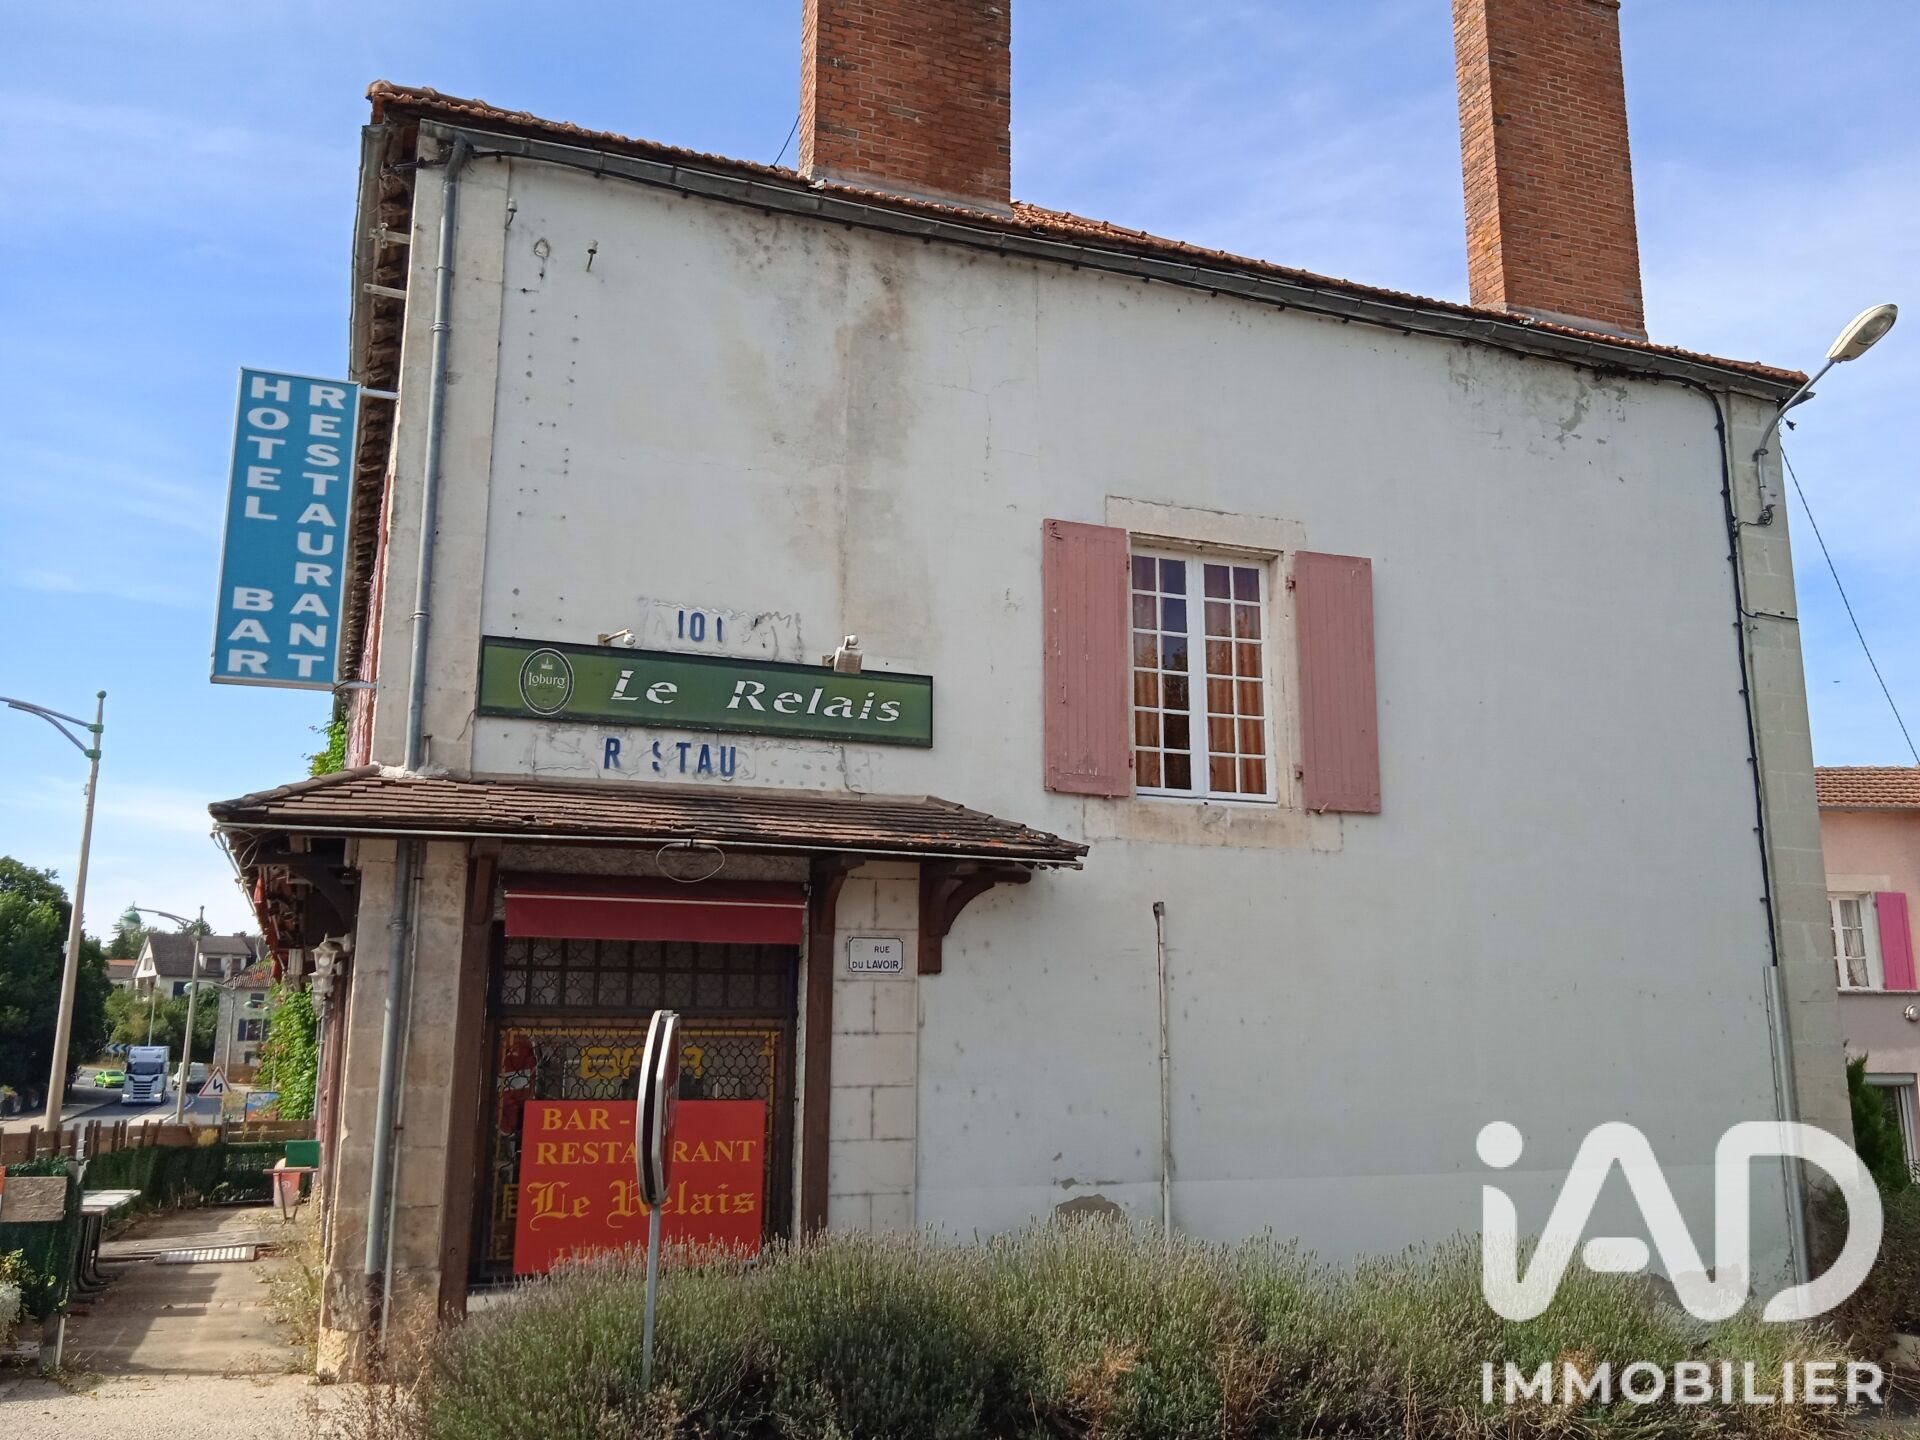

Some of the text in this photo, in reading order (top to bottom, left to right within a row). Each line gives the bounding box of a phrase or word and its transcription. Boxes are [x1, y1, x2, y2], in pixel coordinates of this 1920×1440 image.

[244, 376, 291, 521] HOTEL
[287, 383, 347, 678] RESTAURANT
[227, 586, 275, 675] BAR
[610, 670, 902, 723] Le Relais
[866, 960, 899, 969] LAVOIR
[874, 945, 890, 953] RUE
[541, 1108, 610, 1131] BAR
[535, 1140, 756, 1165] RESTARANT
[526, 1181, 591, 1232] Le
